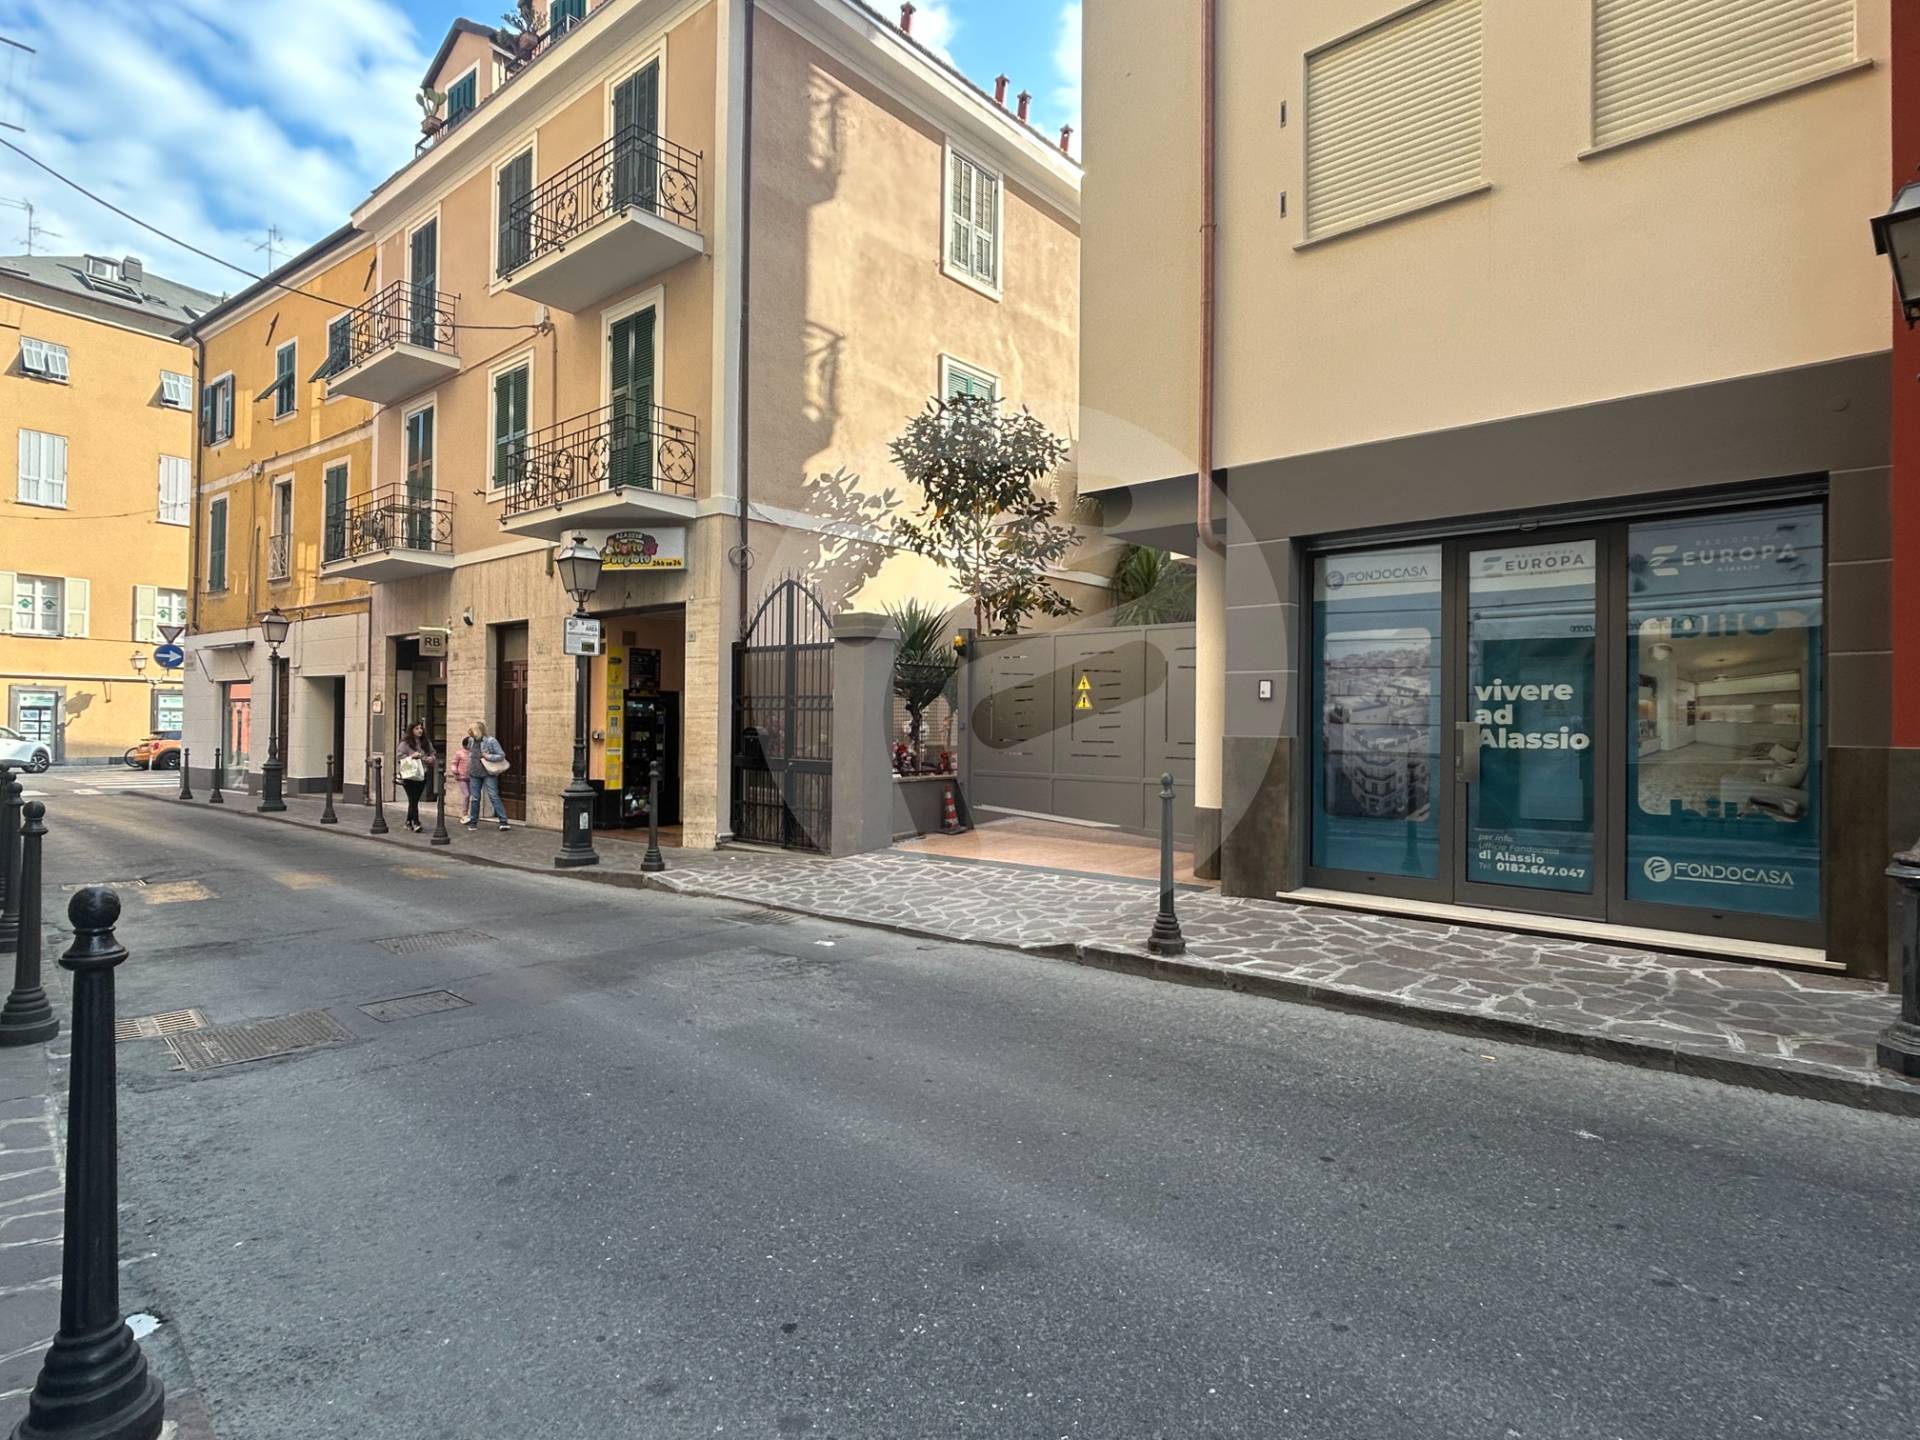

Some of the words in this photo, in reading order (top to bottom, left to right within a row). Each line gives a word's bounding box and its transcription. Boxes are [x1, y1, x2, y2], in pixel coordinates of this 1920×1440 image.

[1505, 554, 1585, 571] EUROPA
[1682, 544, 1798, 566] EUROPA
[1346, 566, 1429, 581] FONDOCASA
[424, 637, 441, 647] RB
[1474, 678, 1574, 701] vivere
[1474, 703, 1513, 725] ad
[1479, 725, 1591, 750] Alassio
[1478, 850, 1491, 860] di
[1495, 852, 1545, 864] Alassio
[1496, 862, 1586, 878] 0182.647.047
[1673, 863, 1795, 885] FONDOCASA
